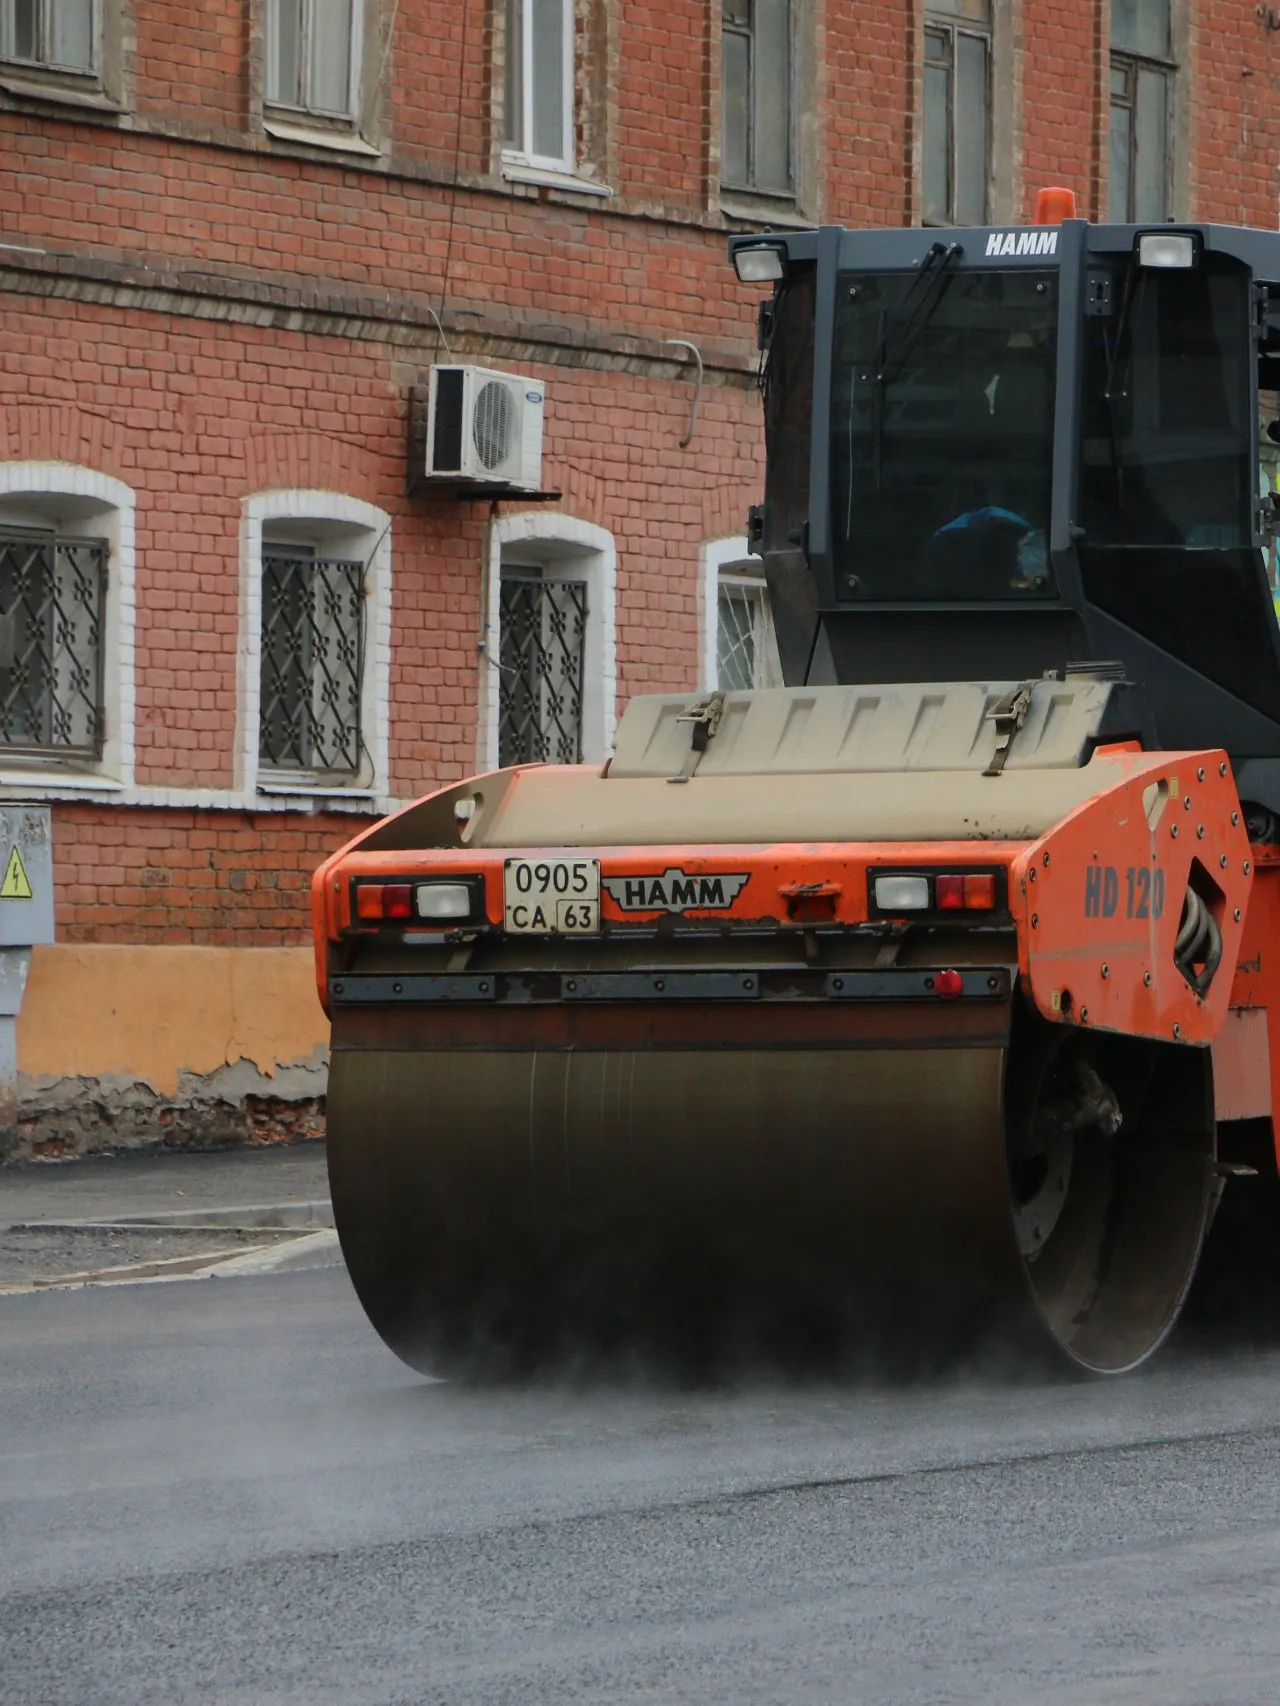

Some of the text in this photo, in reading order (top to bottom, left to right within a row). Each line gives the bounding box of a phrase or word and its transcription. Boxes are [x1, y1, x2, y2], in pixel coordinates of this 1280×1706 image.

[985, 232, 1058, 256] HAMM
[516, 863, 588, 893] 0905
[625, 879, 725, 906] HAMM
[1085, 866, 1166, 919] HD 120
[564, 904, 591, 928] 63
